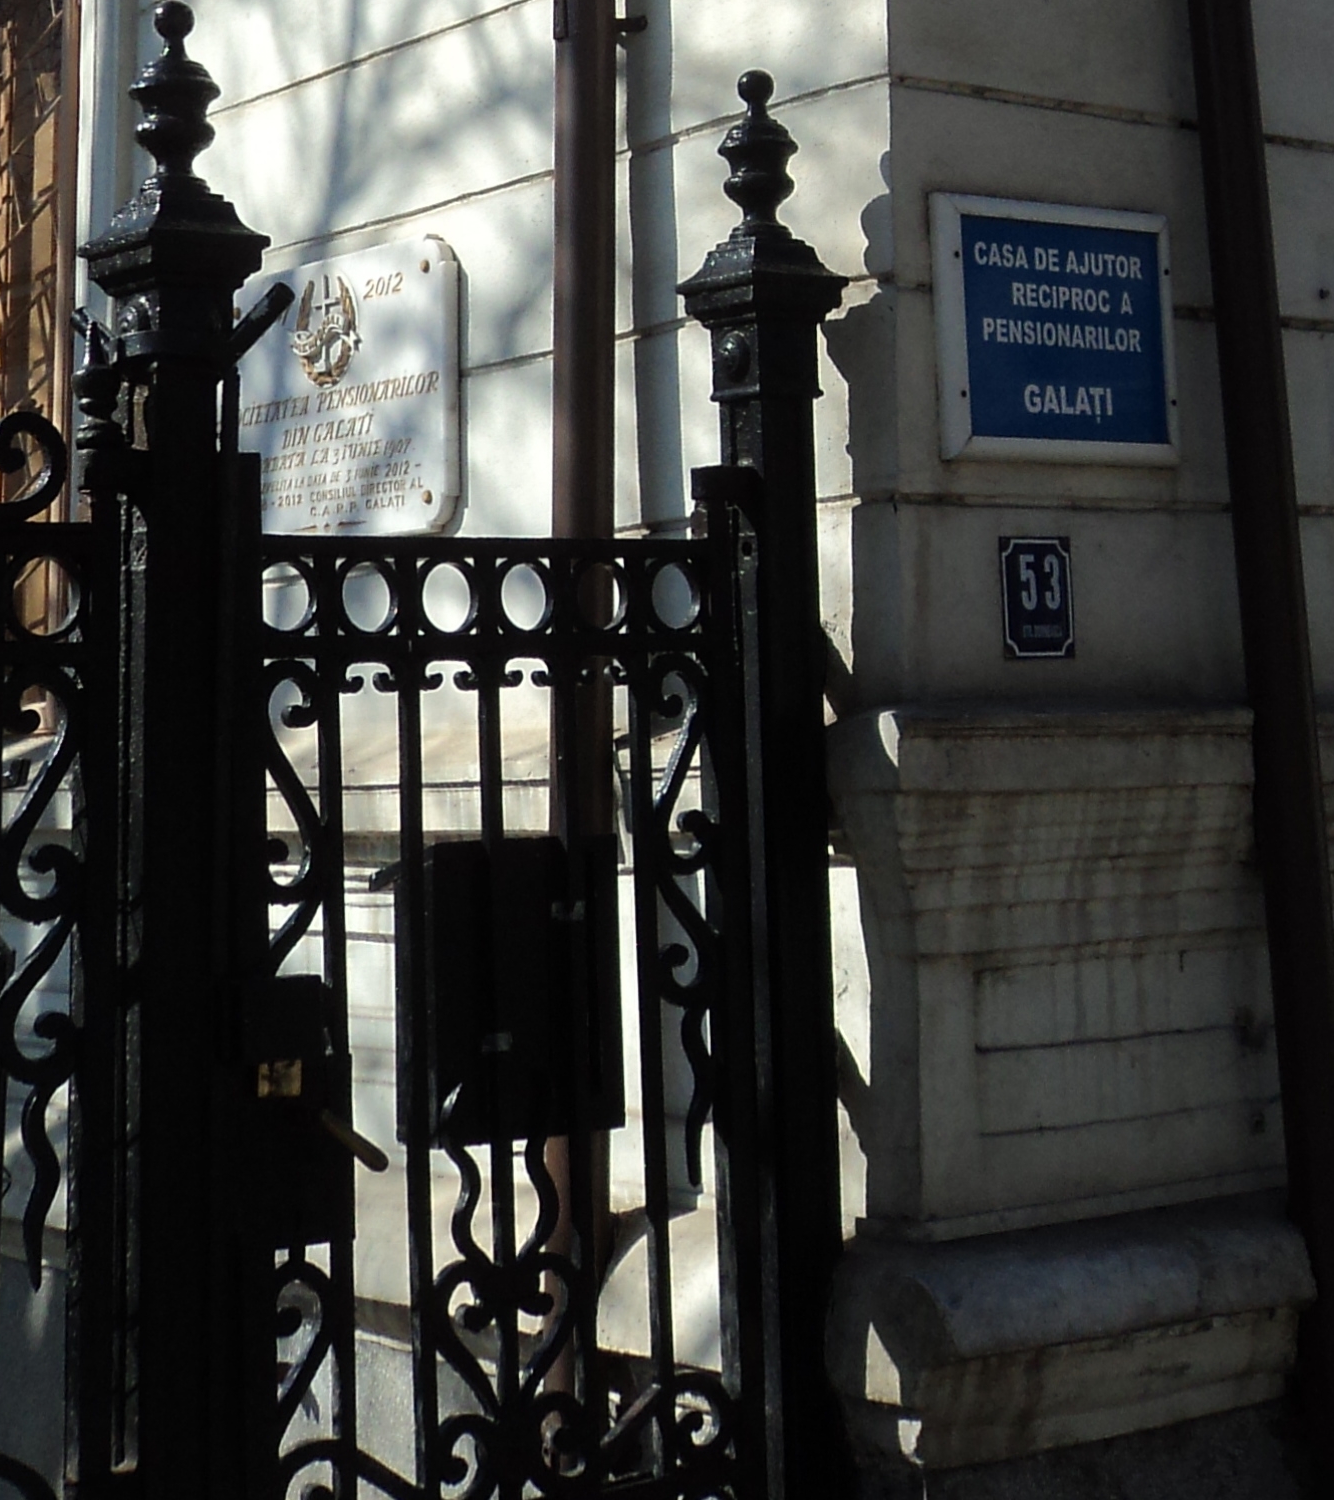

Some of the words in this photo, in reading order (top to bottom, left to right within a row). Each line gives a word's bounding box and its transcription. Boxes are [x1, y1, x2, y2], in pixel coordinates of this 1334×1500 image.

[974, 241, 1029, 269] CASA
[1034, 247, 1060, 272] DE
[1066, 250, 1143, 279] AJUTOR
[363, 272, 404, 301] 2012
[1012, 282, 1110, 313] RECIPROC
[1120, 292, 1133, 315] A
[983, 318, 1142, 352] PENSIONARILOR
[1024, 384, 1113, 424] GALAȚI
[385, 460, 411, 478] 2012
[1019, 554, 1062, 610] 53
